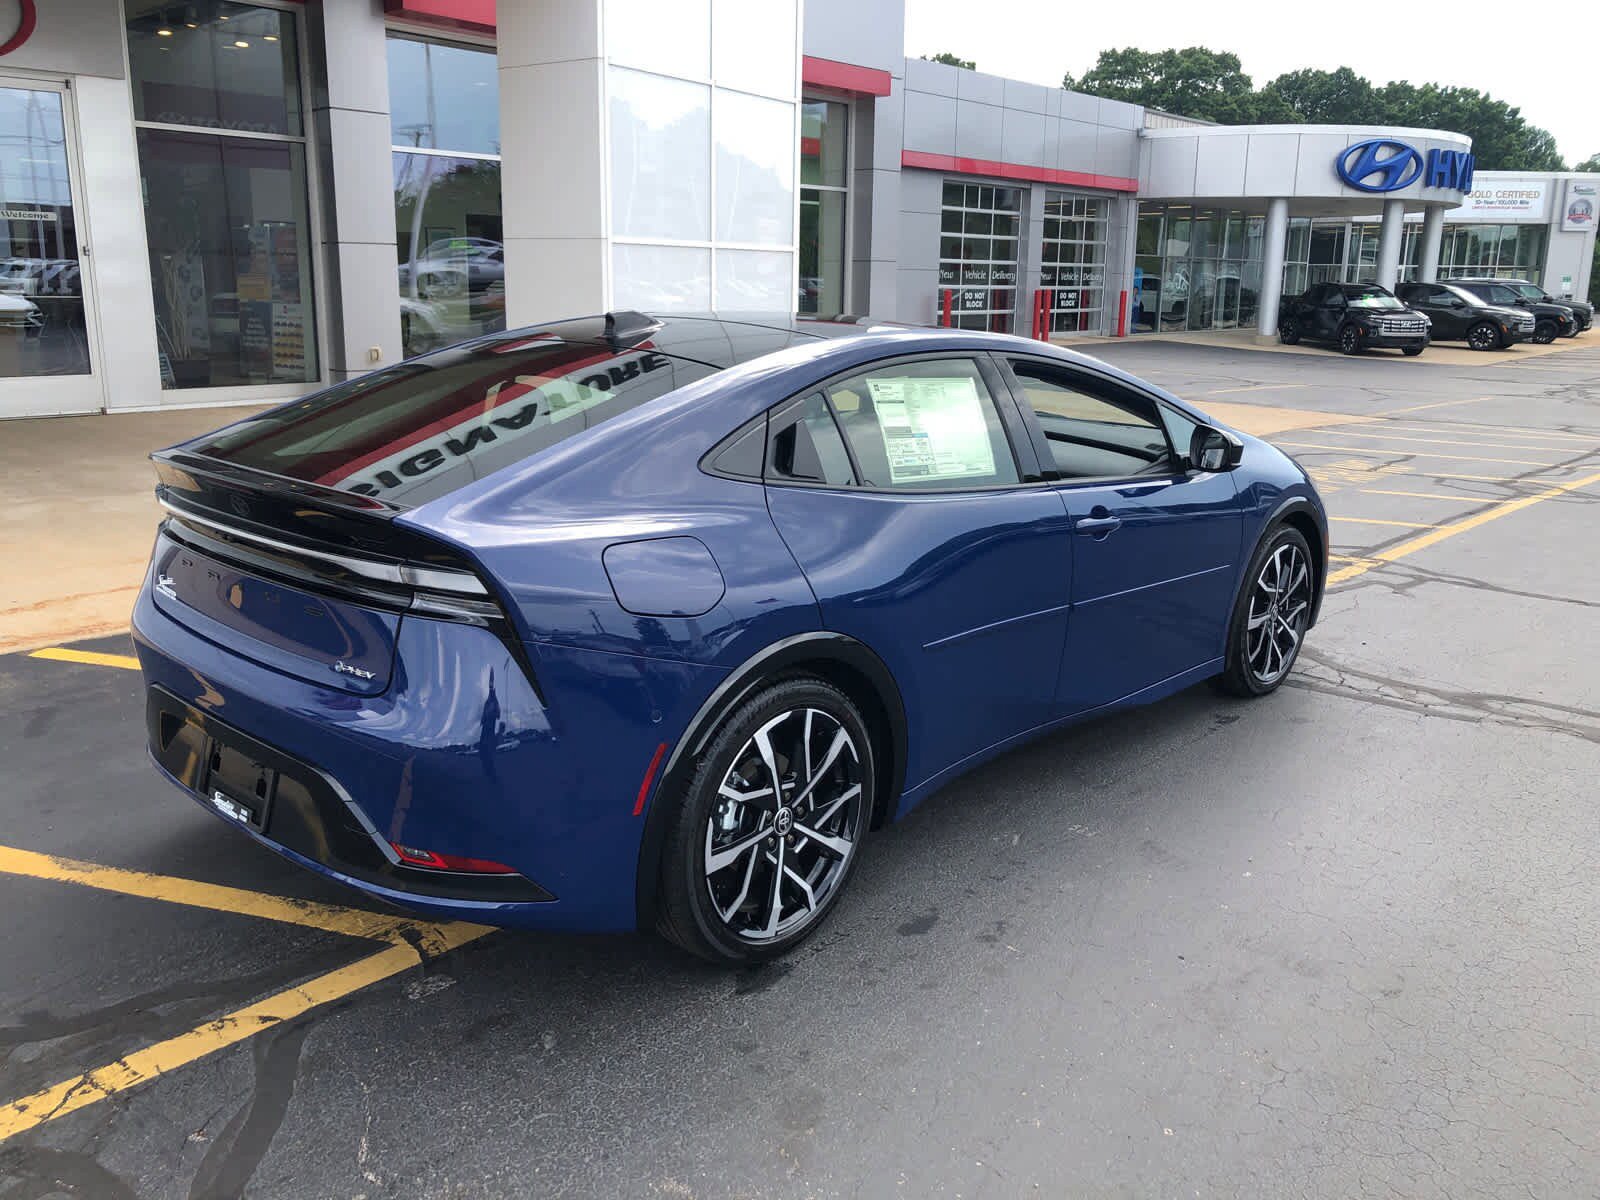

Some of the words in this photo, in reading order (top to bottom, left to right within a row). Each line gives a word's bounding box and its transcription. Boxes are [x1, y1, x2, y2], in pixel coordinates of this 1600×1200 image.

[1495, 190, 1540, 199] CERTIFIED
[0, 210, 49, 219] Welcome
[964, 269, 987, 280] Vehicle
[991, 270, 1016, 282] Delivery
[1060, 271, 1079, 281] Vehicle
[1082, 272, 1104, 282] Delivery
[964, 291, 973, 300] DO
[974, 291, 985, 300] NOT
[1059, 291, 1067, 300] DO
[1067, 291, 1077, 300] NOT
[966, 300, 983, 308] BLOCK
[1060, 299, 1075, 307] BLOCK
